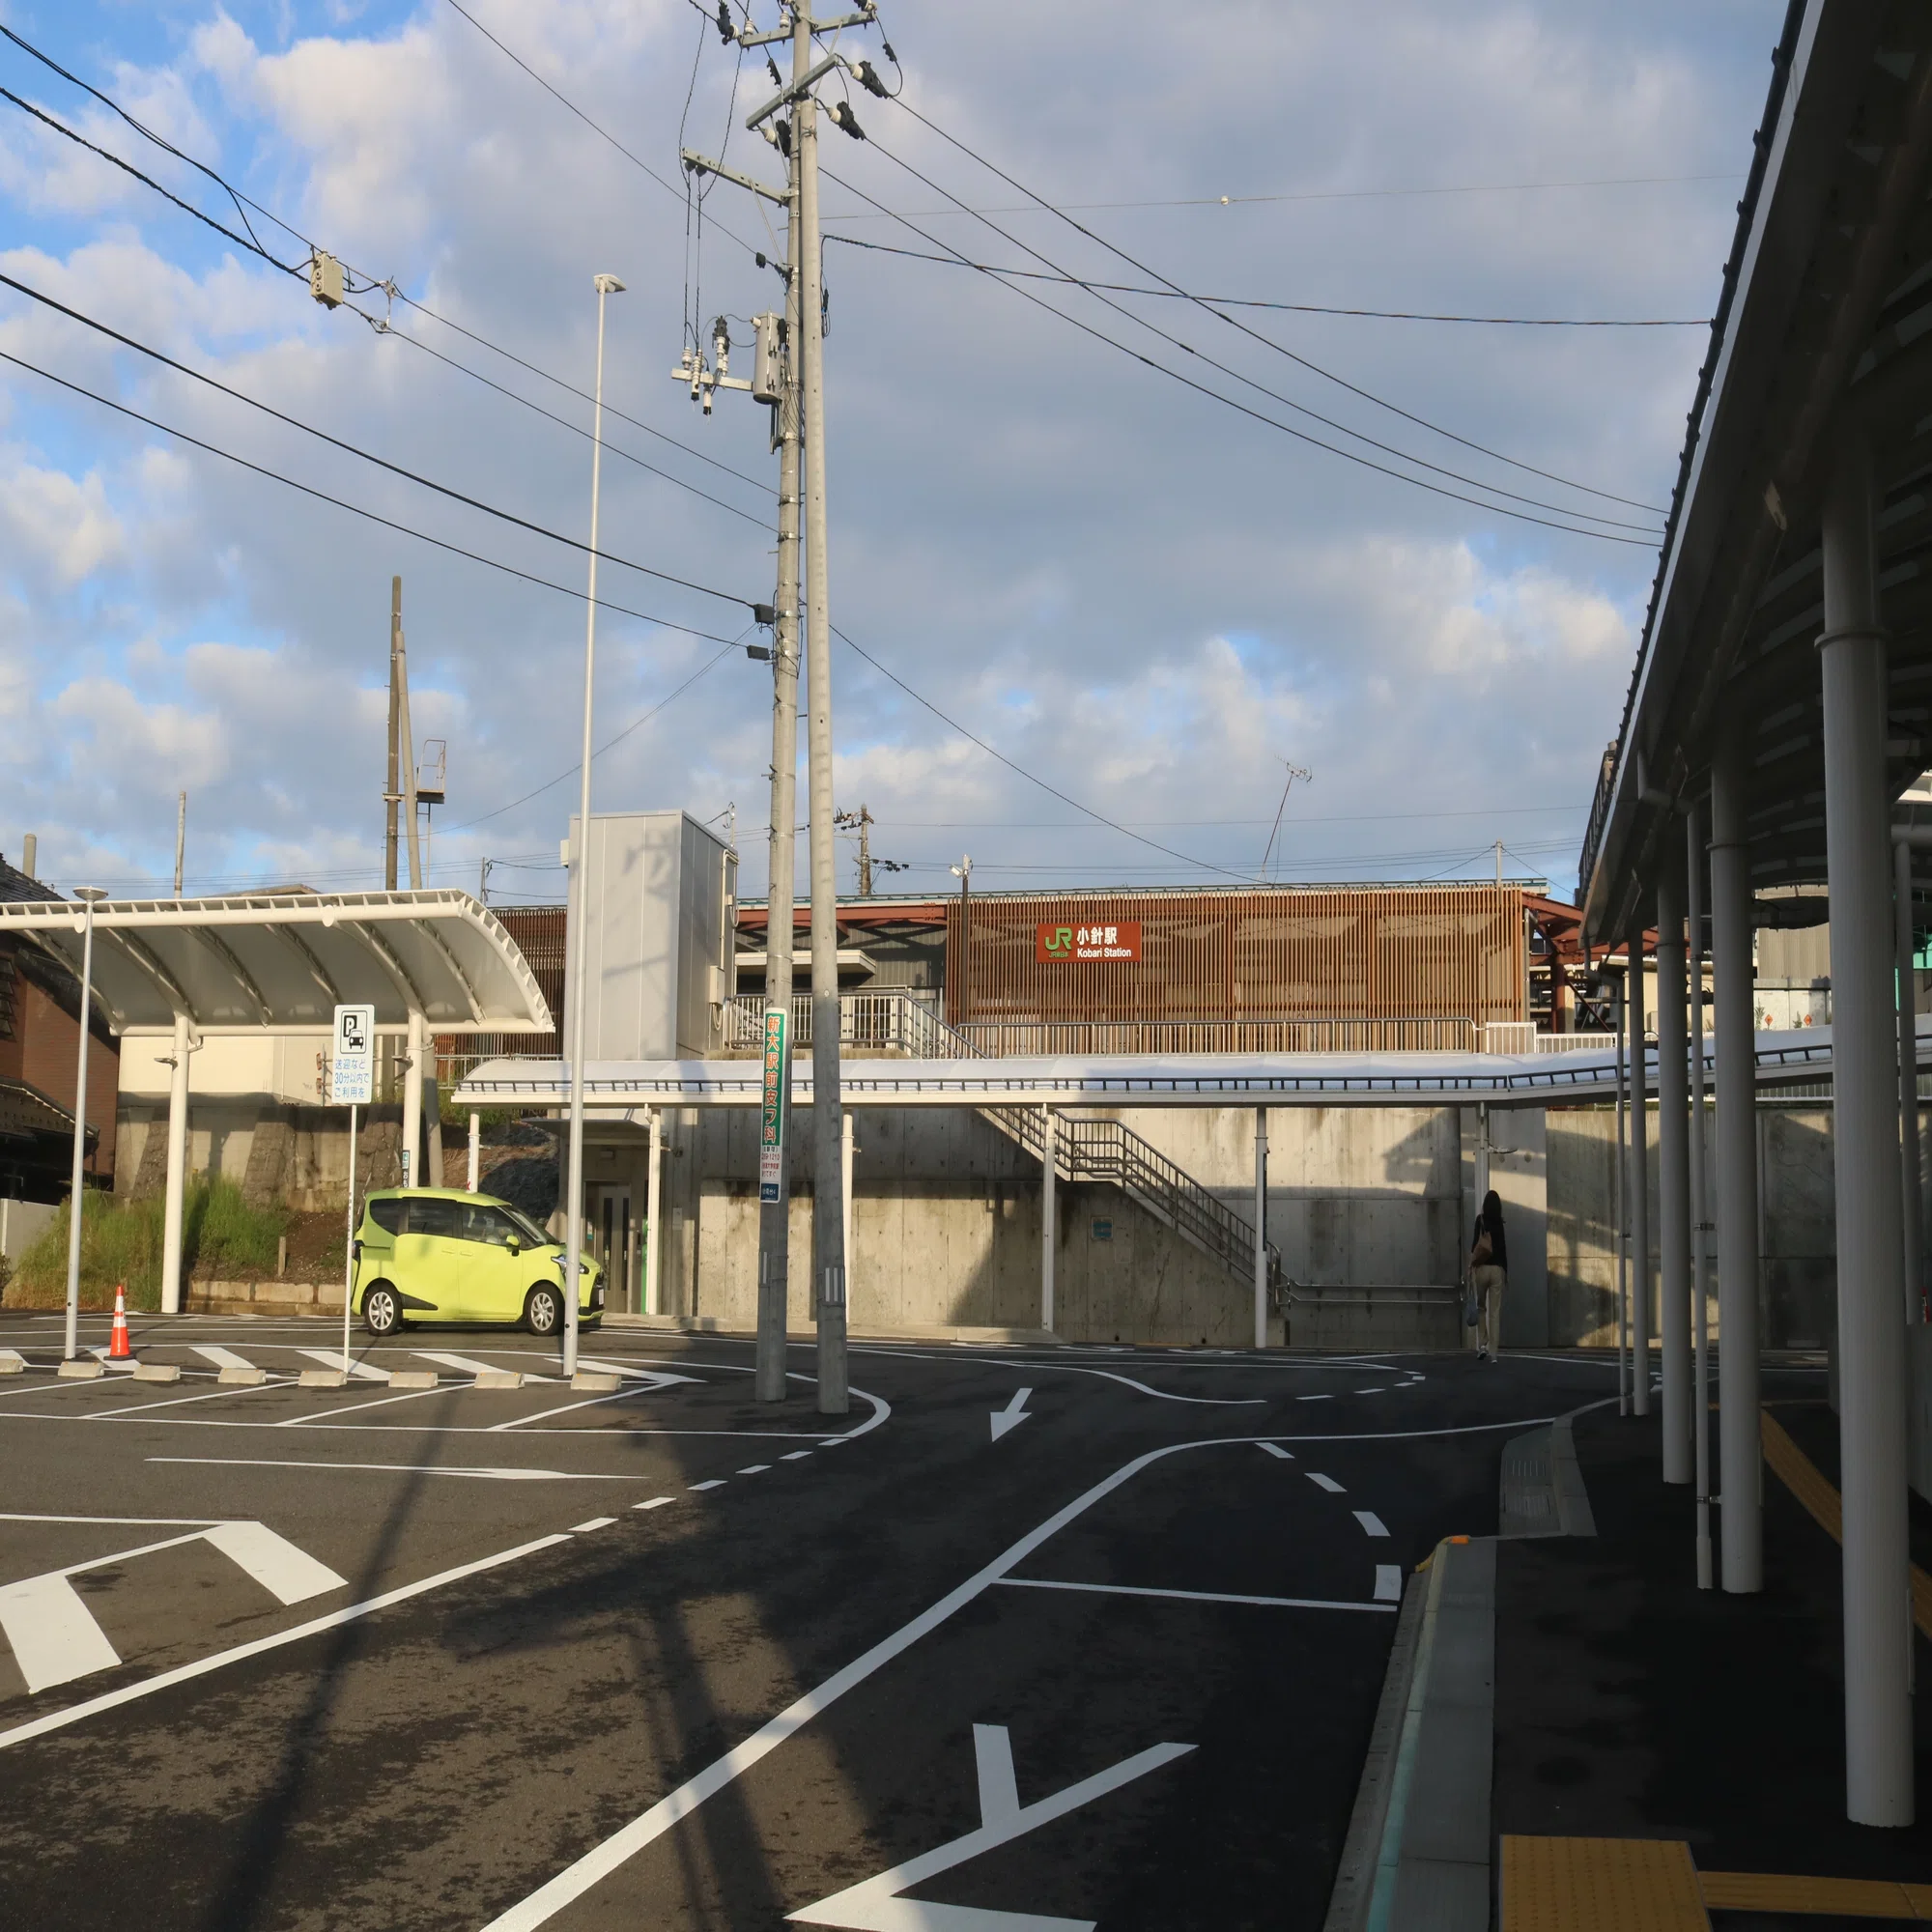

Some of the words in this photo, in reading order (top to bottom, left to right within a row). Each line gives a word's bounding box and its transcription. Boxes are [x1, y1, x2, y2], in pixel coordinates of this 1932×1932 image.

[1045, 927, 1072, 951] JR
[1076, 926, 1118, 946] 小針駅
[1077, 947, 1102, 958] Kobari
[1104, 947, 1131, 958] Station
[335, 1059, 366, 1070] 送迎など
[334, 1072, 370, 1084] 30分以内で
[763, 1014, 781, 1145] 新大駅前皮フ科
[334, 1086, 365, 1098] ご利用を
